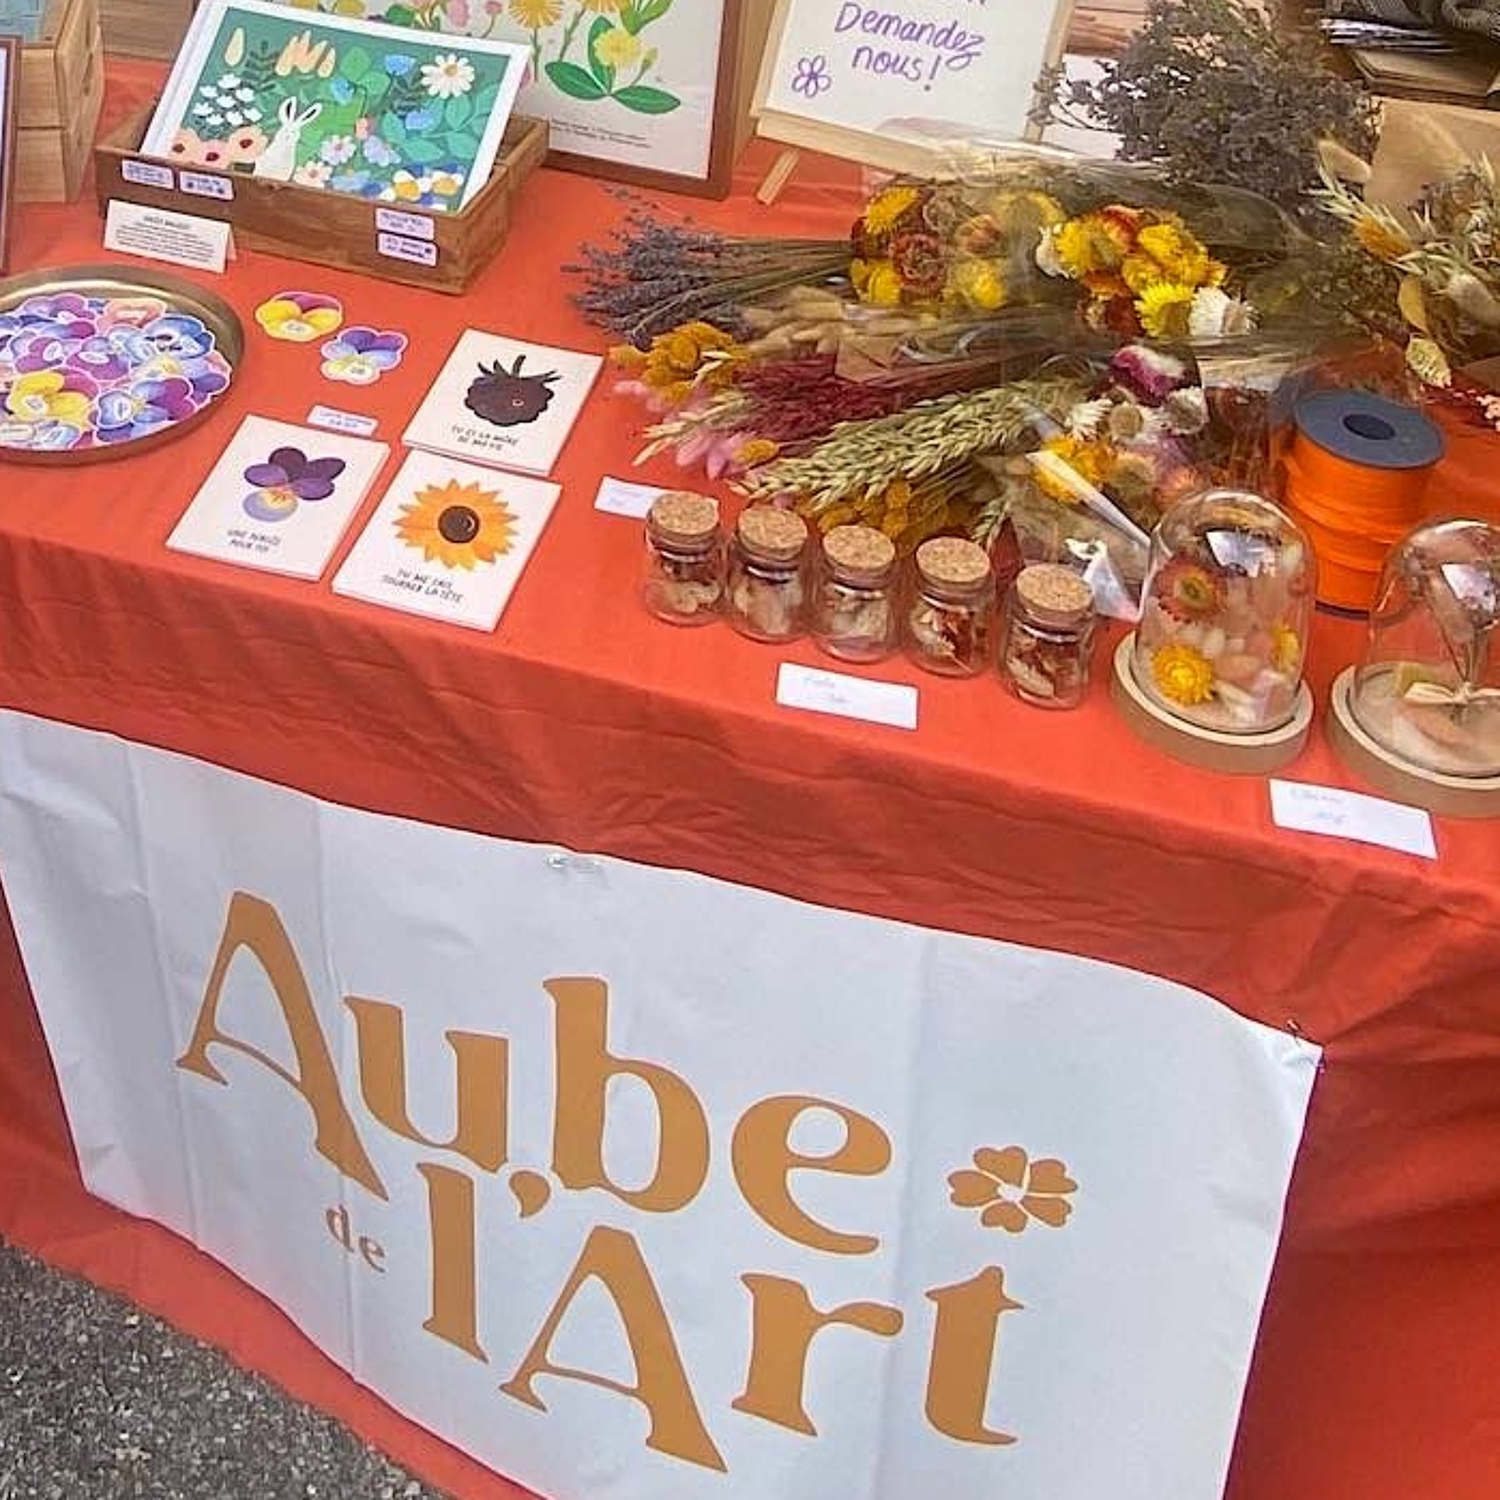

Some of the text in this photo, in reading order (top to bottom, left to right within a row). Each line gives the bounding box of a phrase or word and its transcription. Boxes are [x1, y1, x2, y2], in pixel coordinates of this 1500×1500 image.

[834, 2, 985, 72] Demandez
[852, 46, 941, 92] nous!
[175, 890, 892, 1255] Aube
[325, 1161, 1025, 1474] de l'Art
